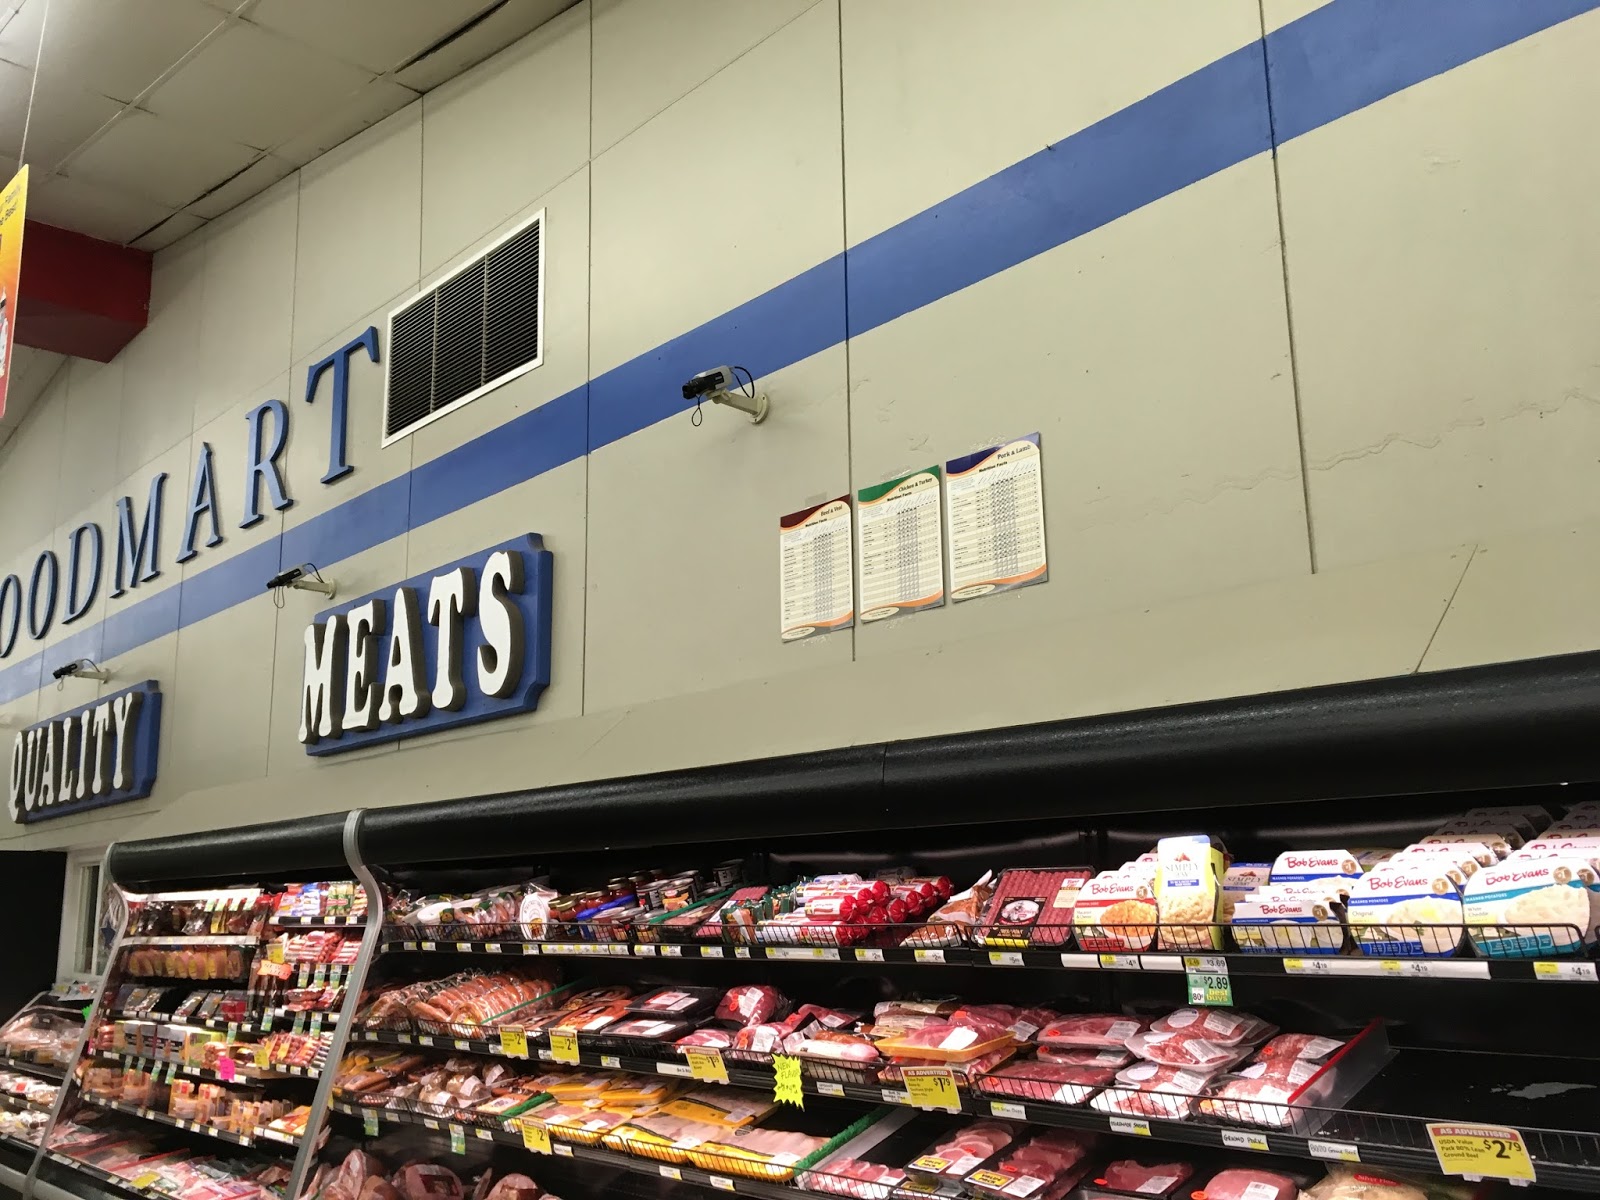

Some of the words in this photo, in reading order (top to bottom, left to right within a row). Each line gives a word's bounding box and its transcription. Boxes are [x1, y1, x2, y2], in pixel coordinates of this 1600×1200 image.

[997, 451, 1011, 460] Pork
[1016, 444, 1032, 454] Lamb
[898, 483, 915, 492] Chicken
[919, 477, 933, 485] Turkey
[298, 550, 526, 745] MEATS
[9, 690, 141, 823] QUALITY
[1285, 857, 1307, 868] Bob
[1308, 856, 1338, 868] Evans
[1511, 867, 1550, 882] Evans
[1090, 883, 1109, 895] Bob
[1109, 881, 1134, 894] Evans
[1367, 877, 1394, 890] Bob
[1394, 876, 1428, 889] Evans
[1259, 904, 1279, 914] Bob
[1278, 904, 1303, 914] Evans
[1351, 910, 1374, 918] Original
[1207, 959, 1226, 967] $3.69
[1204, 976, 1229, 990] $2.89
[1206, 994, 1228, 1003] buys
[777, 1062, 790, 1071] NEW
[933, 1077, 951, 1093] $179
[1440, 1127, 1453, 1135] AS
[1454, 1128, 1511, 1139] ADVERTISED
